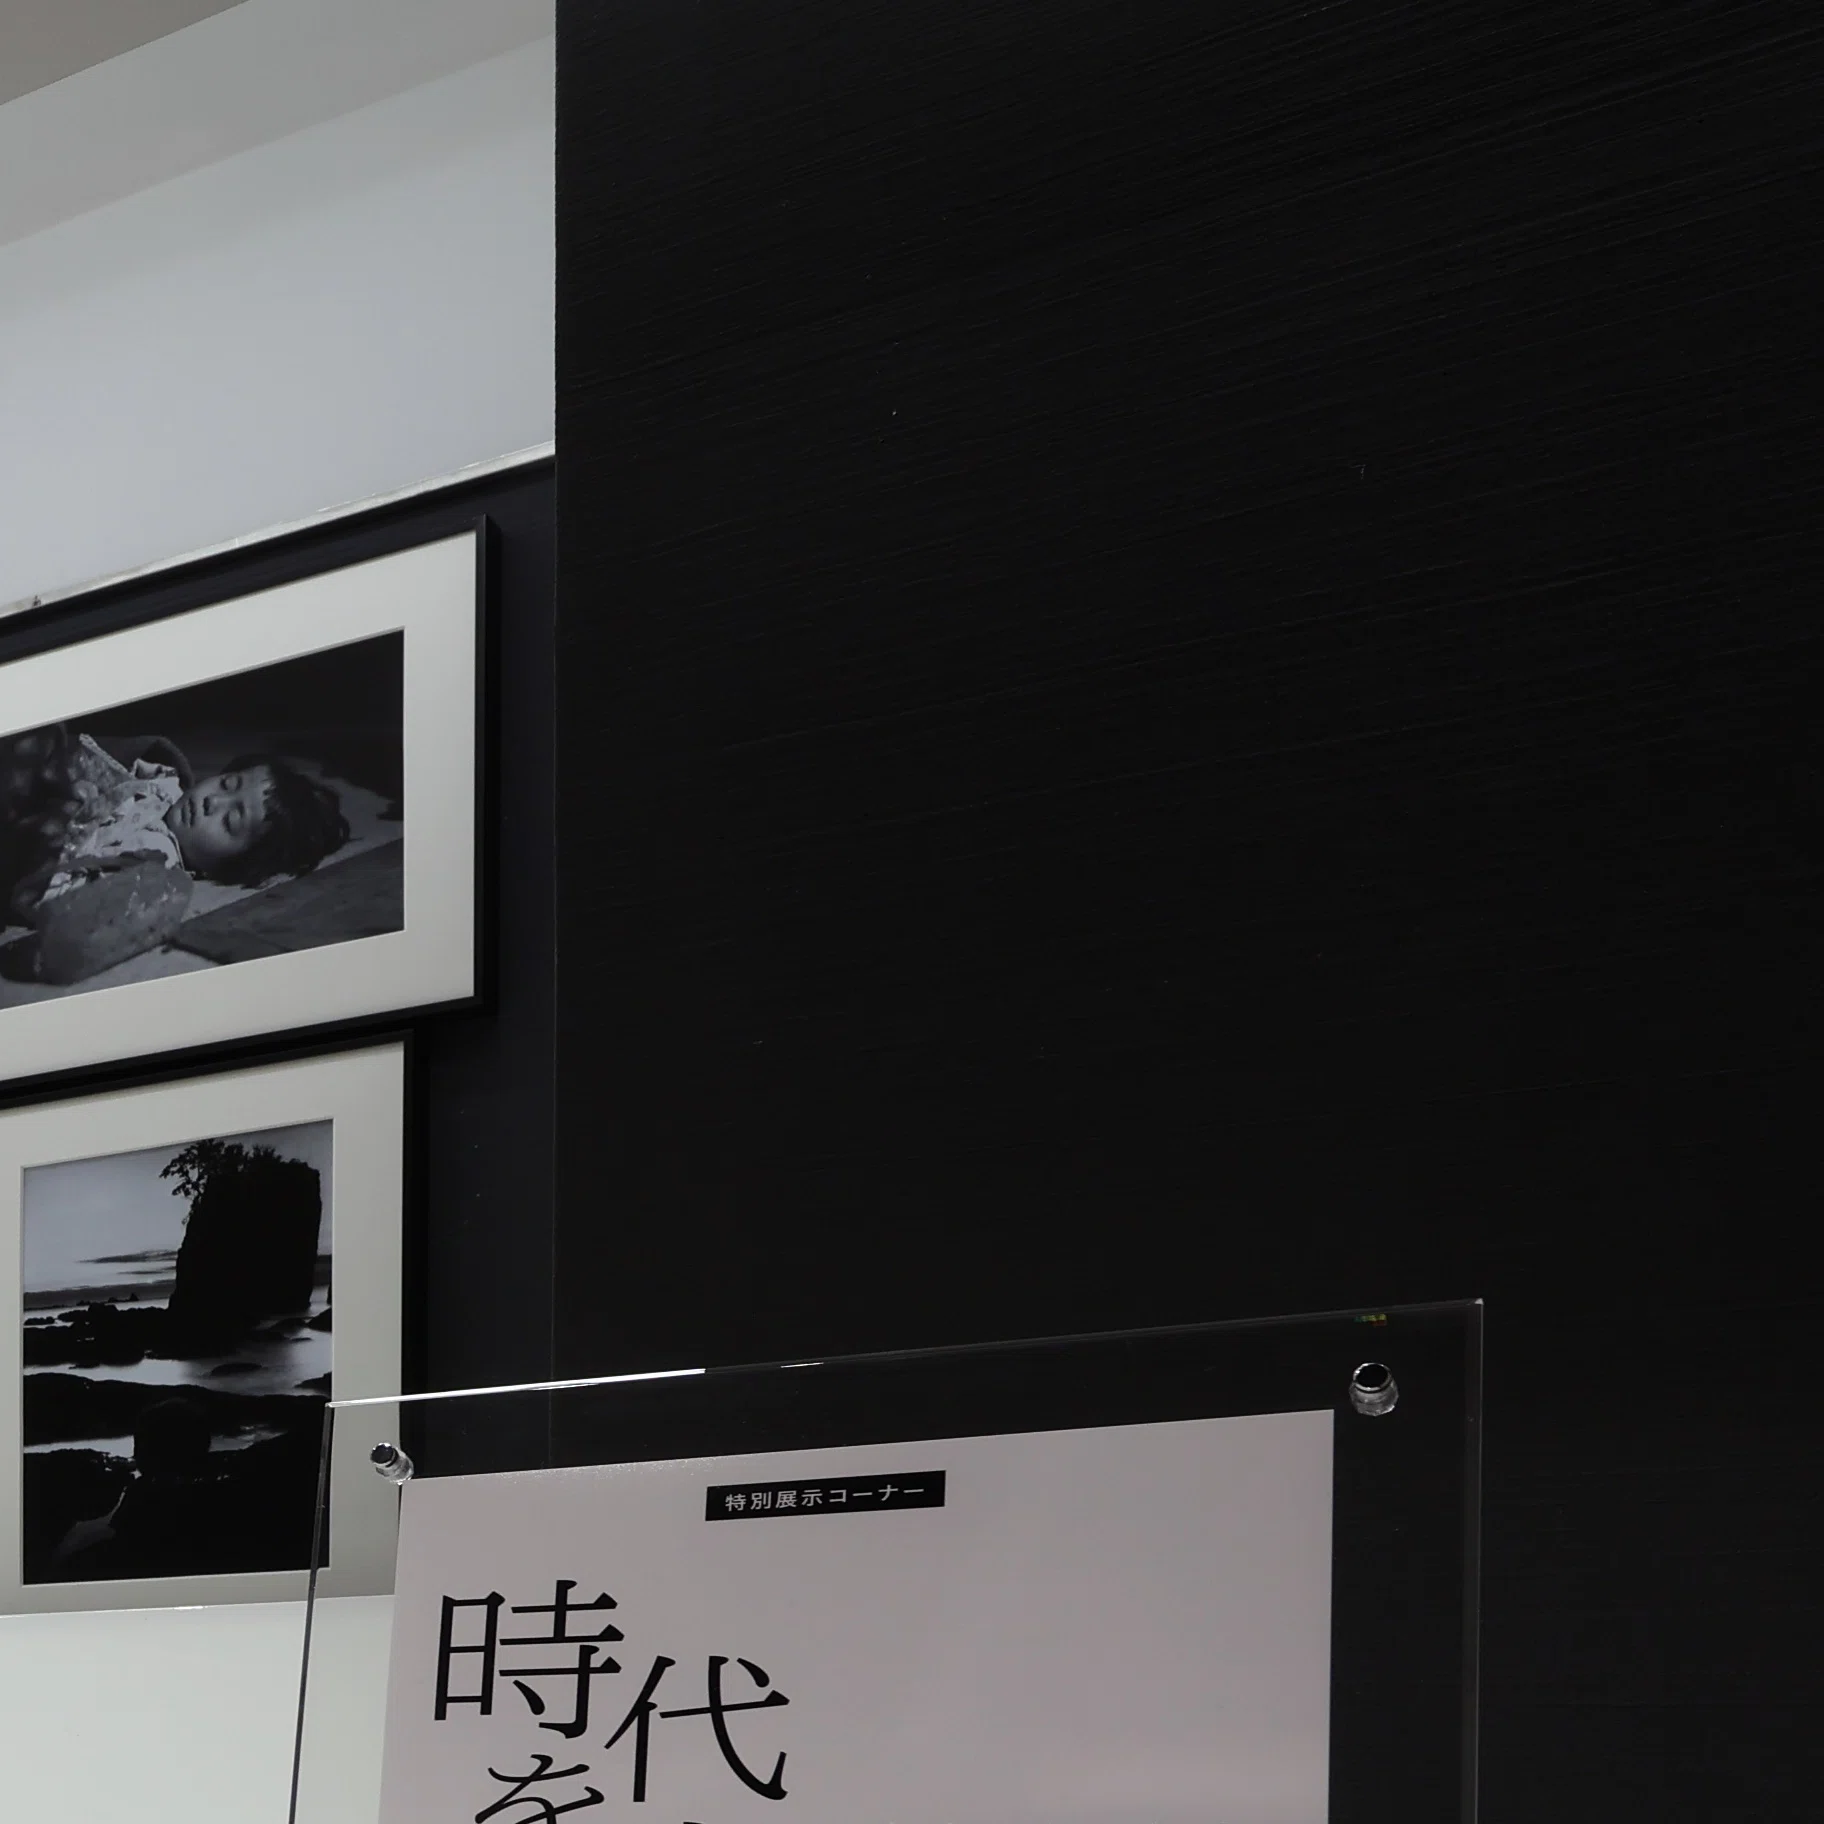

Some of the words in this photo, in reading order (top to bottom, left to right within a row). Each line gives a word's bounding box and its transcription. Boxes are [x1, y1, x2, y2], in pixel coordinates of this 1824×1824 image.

[724, 1482, 927, 1514] 特別展示コーナー
